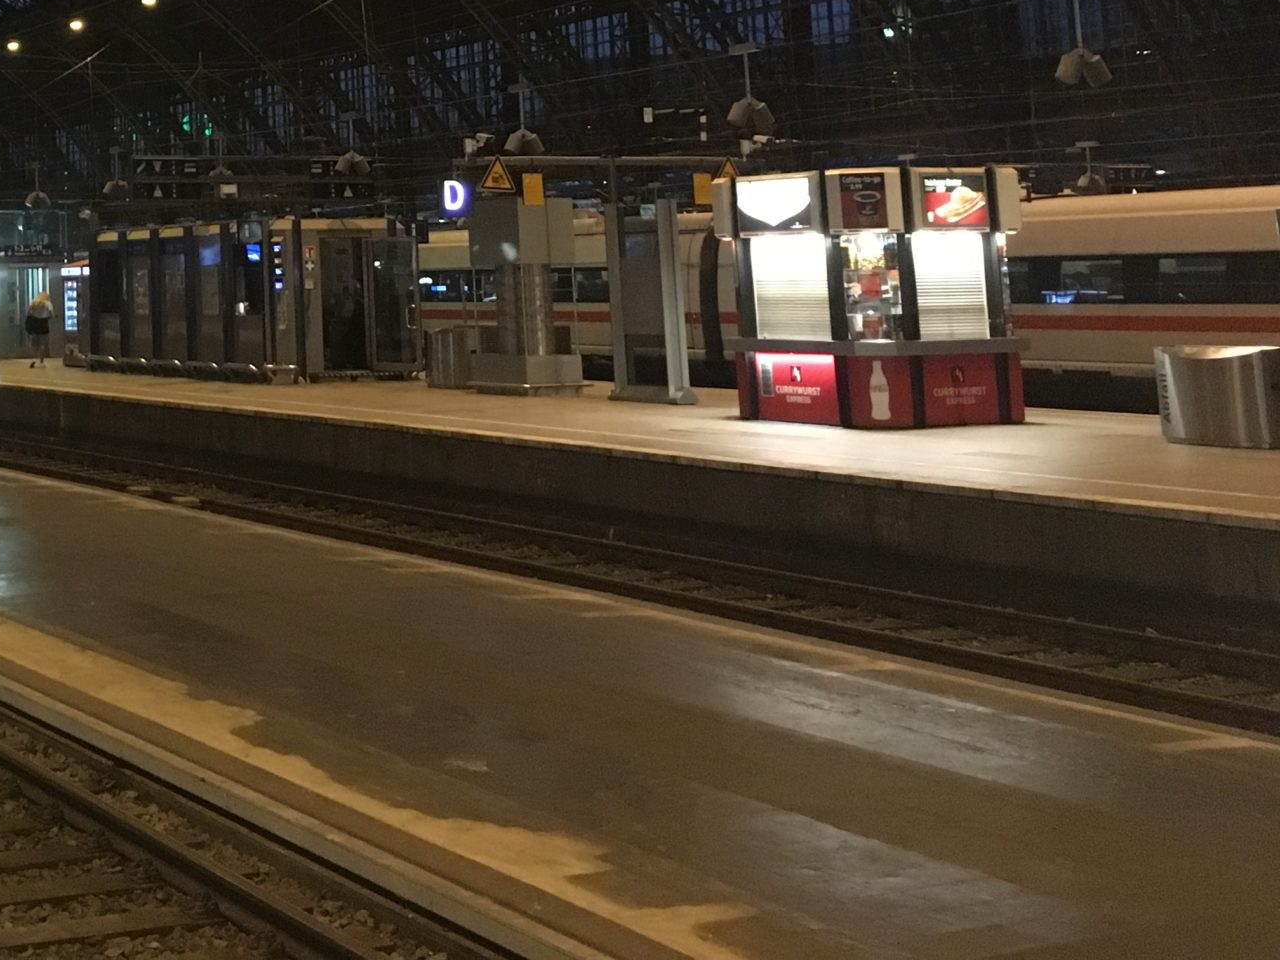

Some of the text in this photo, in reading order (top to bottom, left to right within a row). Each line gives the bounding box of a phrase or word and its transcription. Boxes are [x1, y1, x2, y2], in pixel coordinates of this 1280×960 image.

[443, 180, 465, 211] D
[775, 385, 821, 397] CURRYWURST
[932, 386, 986, 397] CURRYWURST
[1159, 373, 1172, 424] Abfall
